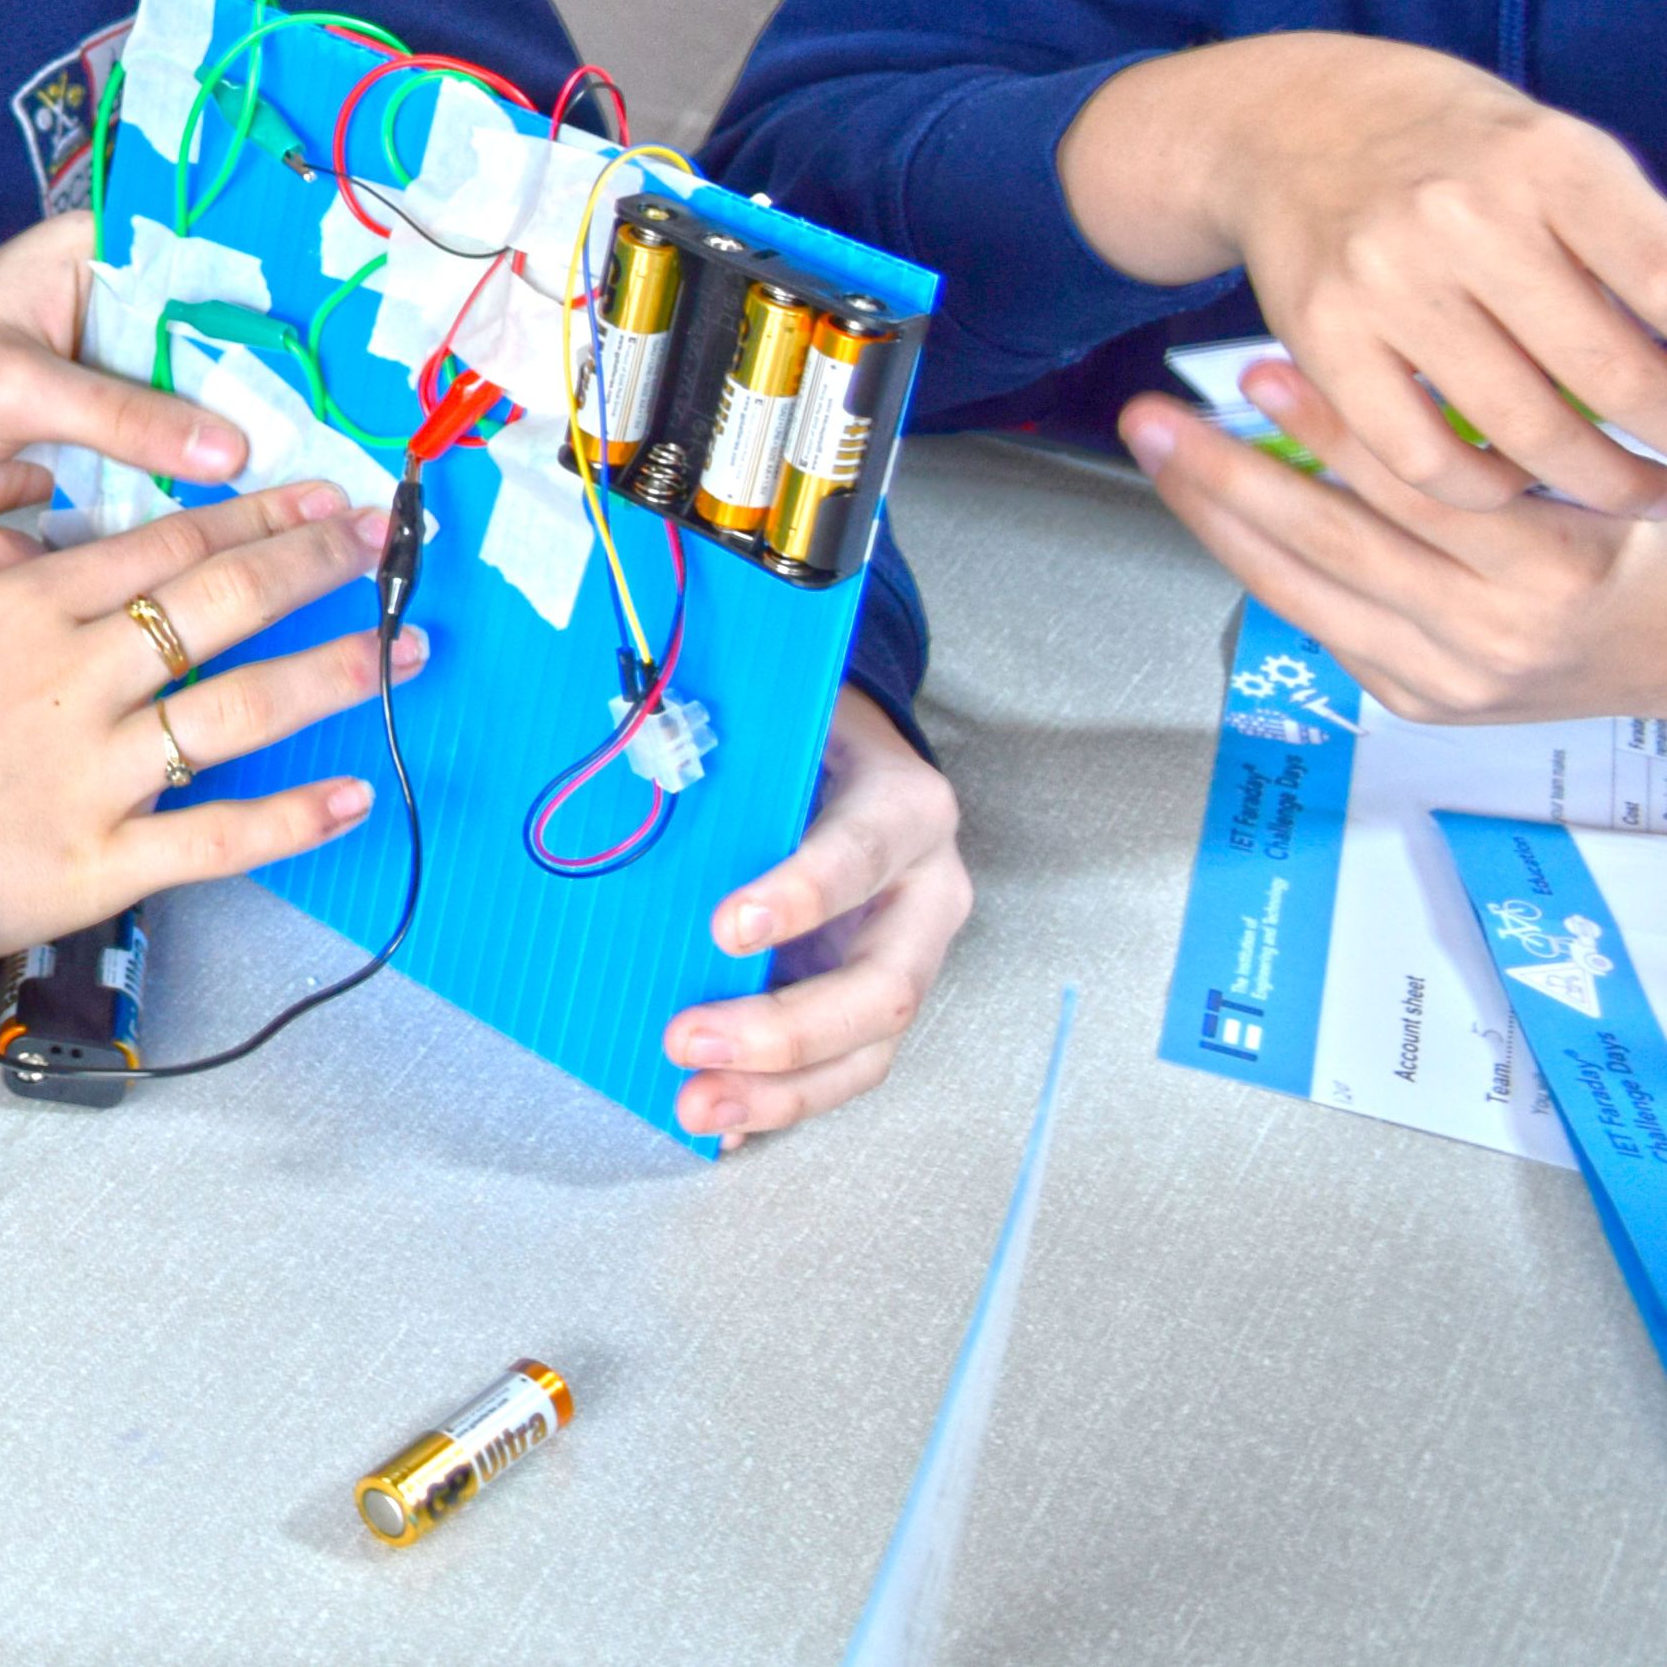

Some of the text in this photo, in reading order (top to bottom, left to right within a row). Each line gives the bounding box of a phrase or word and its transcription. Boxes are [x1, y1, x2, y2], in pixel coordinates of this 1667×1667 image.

[1263, 754, 1308, 861] Challenge Days
[1622, 801, 1641, 825] Cost
[1229, 828, 1255, 854] IET
[1513, 836, 1553, 896] Education
[1234, 928, 1257, 977] Institution
[1250, 876, 1290, 1001] Engineering and Technology
[1230, 975, 1250, 995] The
[1198, 987, 1264, 1063] IET
[1393, 974, 1427, 1084] Account sheet
[1596, 1031, 1634, 1075] Days
[1604, 1128, 1644, 1160] IET
[474, 1411, 549, 1484] Ultra
